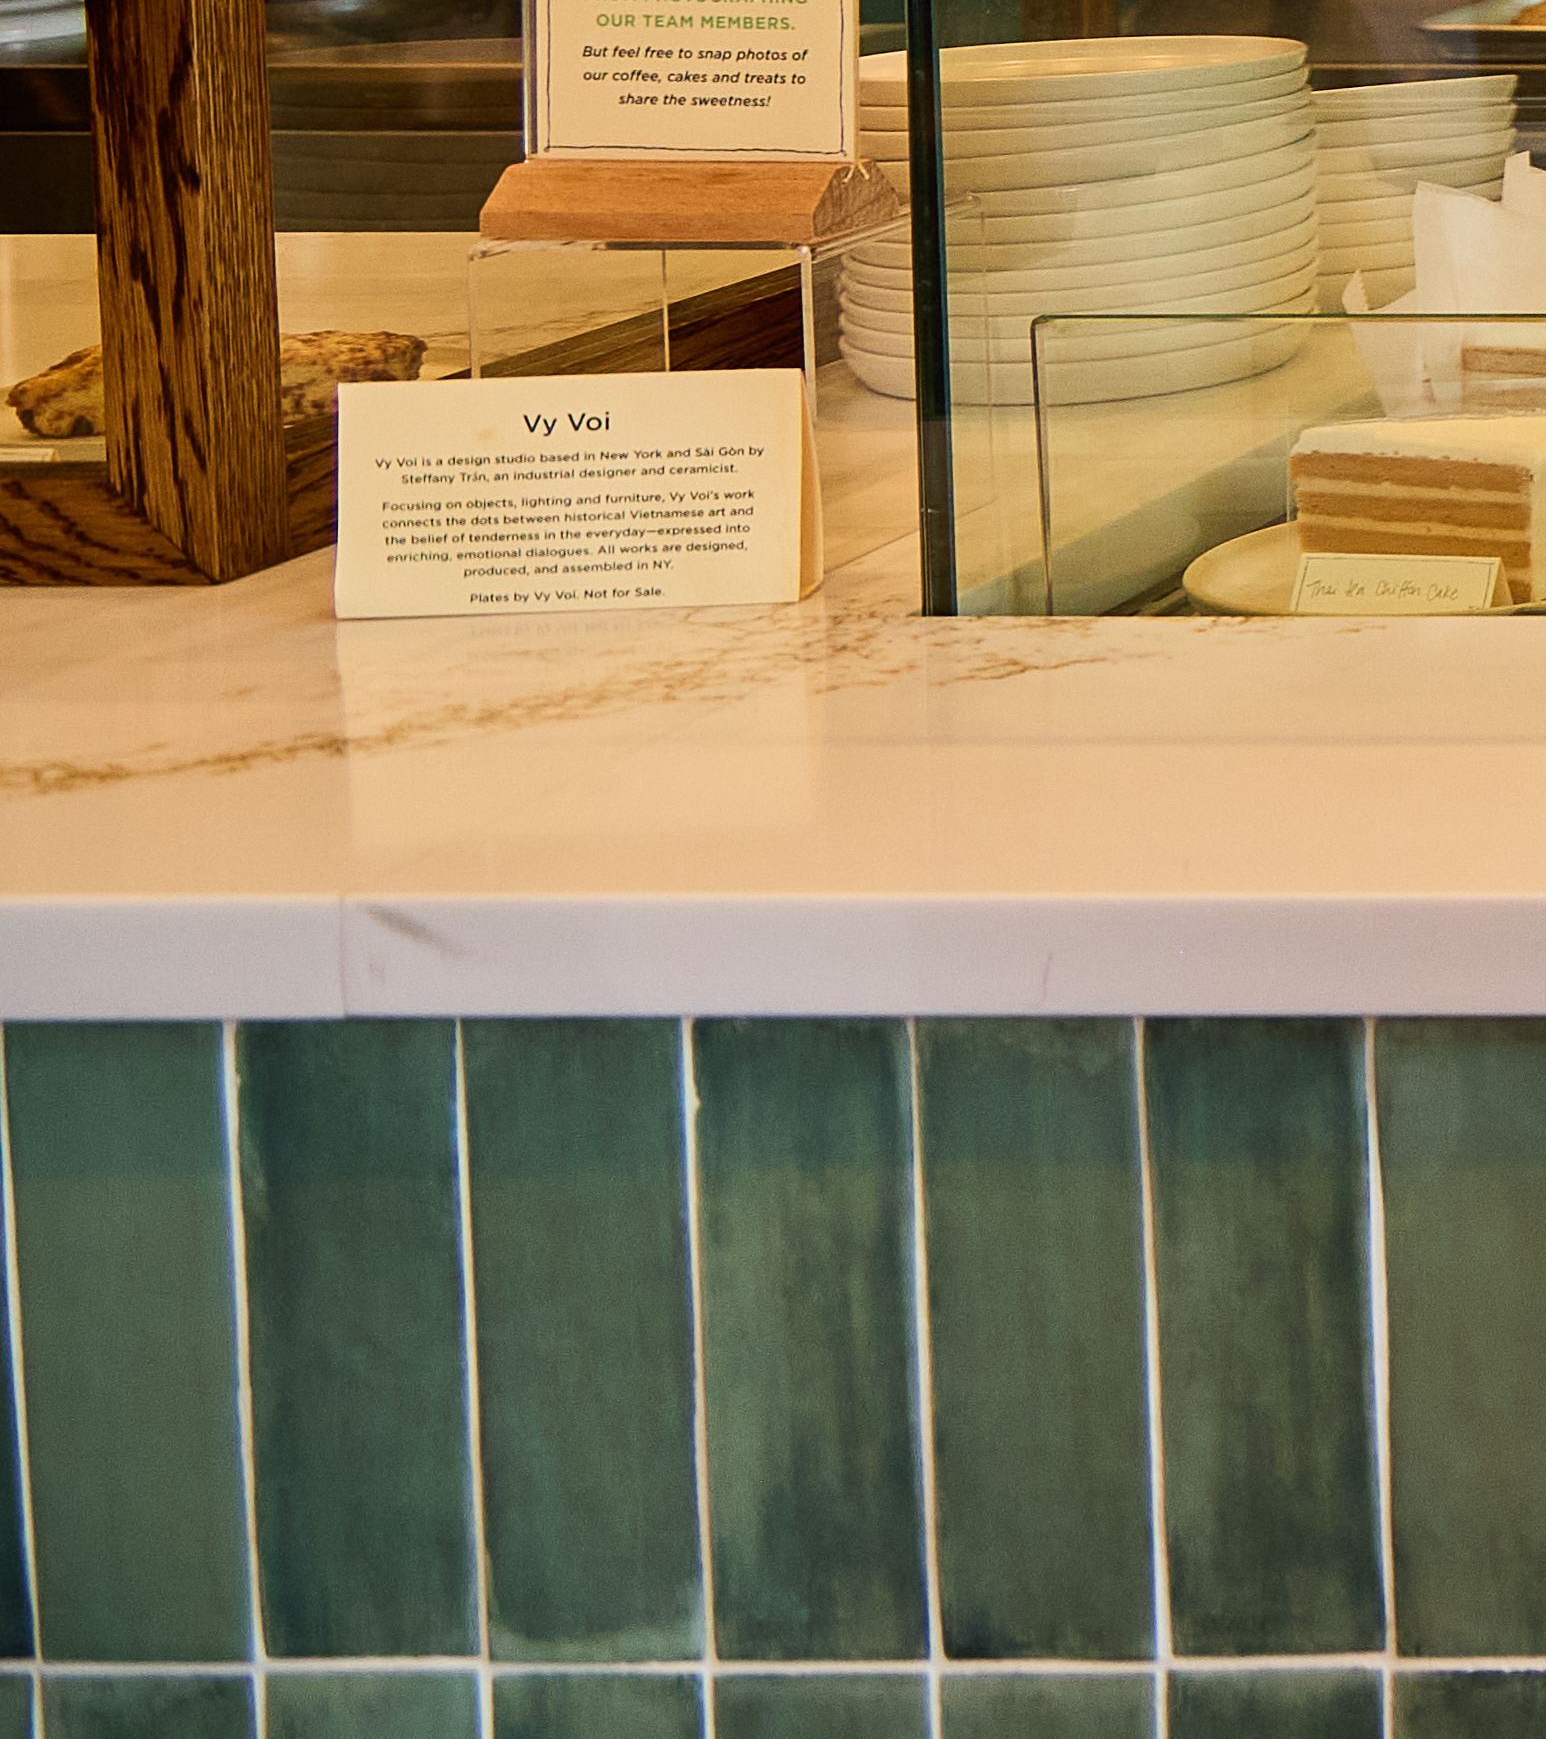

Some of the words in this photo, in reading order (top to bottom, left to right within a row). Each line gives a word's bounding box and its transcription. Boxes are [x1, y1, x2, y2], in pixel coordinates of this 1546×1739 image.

[596, 12, 636, 27] OUR
[642, 13, 693, 28] TEAM
[700, 14, 796, 31] MEMBERS.
[582, 44, 608, 58] But
[612, 44, 641, 58] feel
[644, 45, 674, 59] free
[678, 47, 693, 59] to
[696, 49, 732, 61] snap
[735, 47, 788, 62] photos
[791, 48, 808, 61] of
[582, 70, 609, 81] our
[612, 68, 662, 83] coffee,
[667, 69, 708, 83] cakes
[711, 71, 741, 83] and
[744, 72, 786, 84] treats
[790, 72, 806, 85] to
[618, 92, 658, 105] share
[662, 93, 687, 106] the
[690, 94, 772, 107] sweetness!
[522, 413, 557, 437] Vy
[567, 410, 610, 431] Voi
[374, 458, 392, 470] Vy
[396, 456, 417, 468] Voi
[421, 456, 431, 467] is
[435, 458, 443, 466] a
[447, 455, 491, 467] design
[494, 453, 536, 465] studio
[539, 451, 579, 463] based
[583, 451, 596, 461] in
[600, 450, 628, 460] New
[633, 449, 662, 459] York
[666, 447, 691, 458] and
[748, 445, 764, 457] by
[401, 472, 455, 485] Steffany
[493, 472, 509, 481] an
[513, 468, 574, 480] industrial
[578, 468, 636, 479] designer
[640, 464, 665, 476] and
[668, 463, 738, 475] ceramicist.
[382, 500, 442, 512] Focusing
[445, 500, 462, 510] on
[465, 498, 517, 510] objects,
[521, 496, 572, 508] lighting
[576, 493, 601, 505] and
[605, 492, 666, 504] furniture,
[669, 491, 686, 503] Vy
[723, 488, 754, 499] work
[382, 517, 442, 529] connects
[445, 516, 466, 527] the
[470, 514, 499, 526] dots
[502, 514, 560, 525] between
[564, 509, 625, 522] historical
[629, 508, 704, 520] Vietnamese
[708, 507, 725, 517] art
[729, 505, 754, 516] and
[384, 535, 406, 546] the
[410, 532, 448, 545] belief
[451, 532, 465, 544] of
[468, 531, 540, 543] tenderness
[544, 531, 556, 540] in
[560, 529, 581, 540] the
[725, 523, 750, 533] into
[386, 550, 452, 563] enriching,
[456, 547, 521, 560] emotional
[525, 546, 592, 558] dialogues.
[597, 544, 615, 554] All
[619, 543, 658, 554] works
[661, 543, 682, 552] are
[685, 539, 748, 552] designed,
[463, 564, 530, 579] produced,
[534, 563, 558, 574] and
[562, 560, 632, 573] assembled
[636, 560, 648, 570] in
[652, 559, 673, 570] NY.
[470, 592, 509, 603] Plates
[513, 591, 529, 603] by
[534, 590, 550, 602] Vy
[583, 588, 607, 599] Not
[612, 587, 630, 598] for
[634, 585, 665, 597] Sale.
